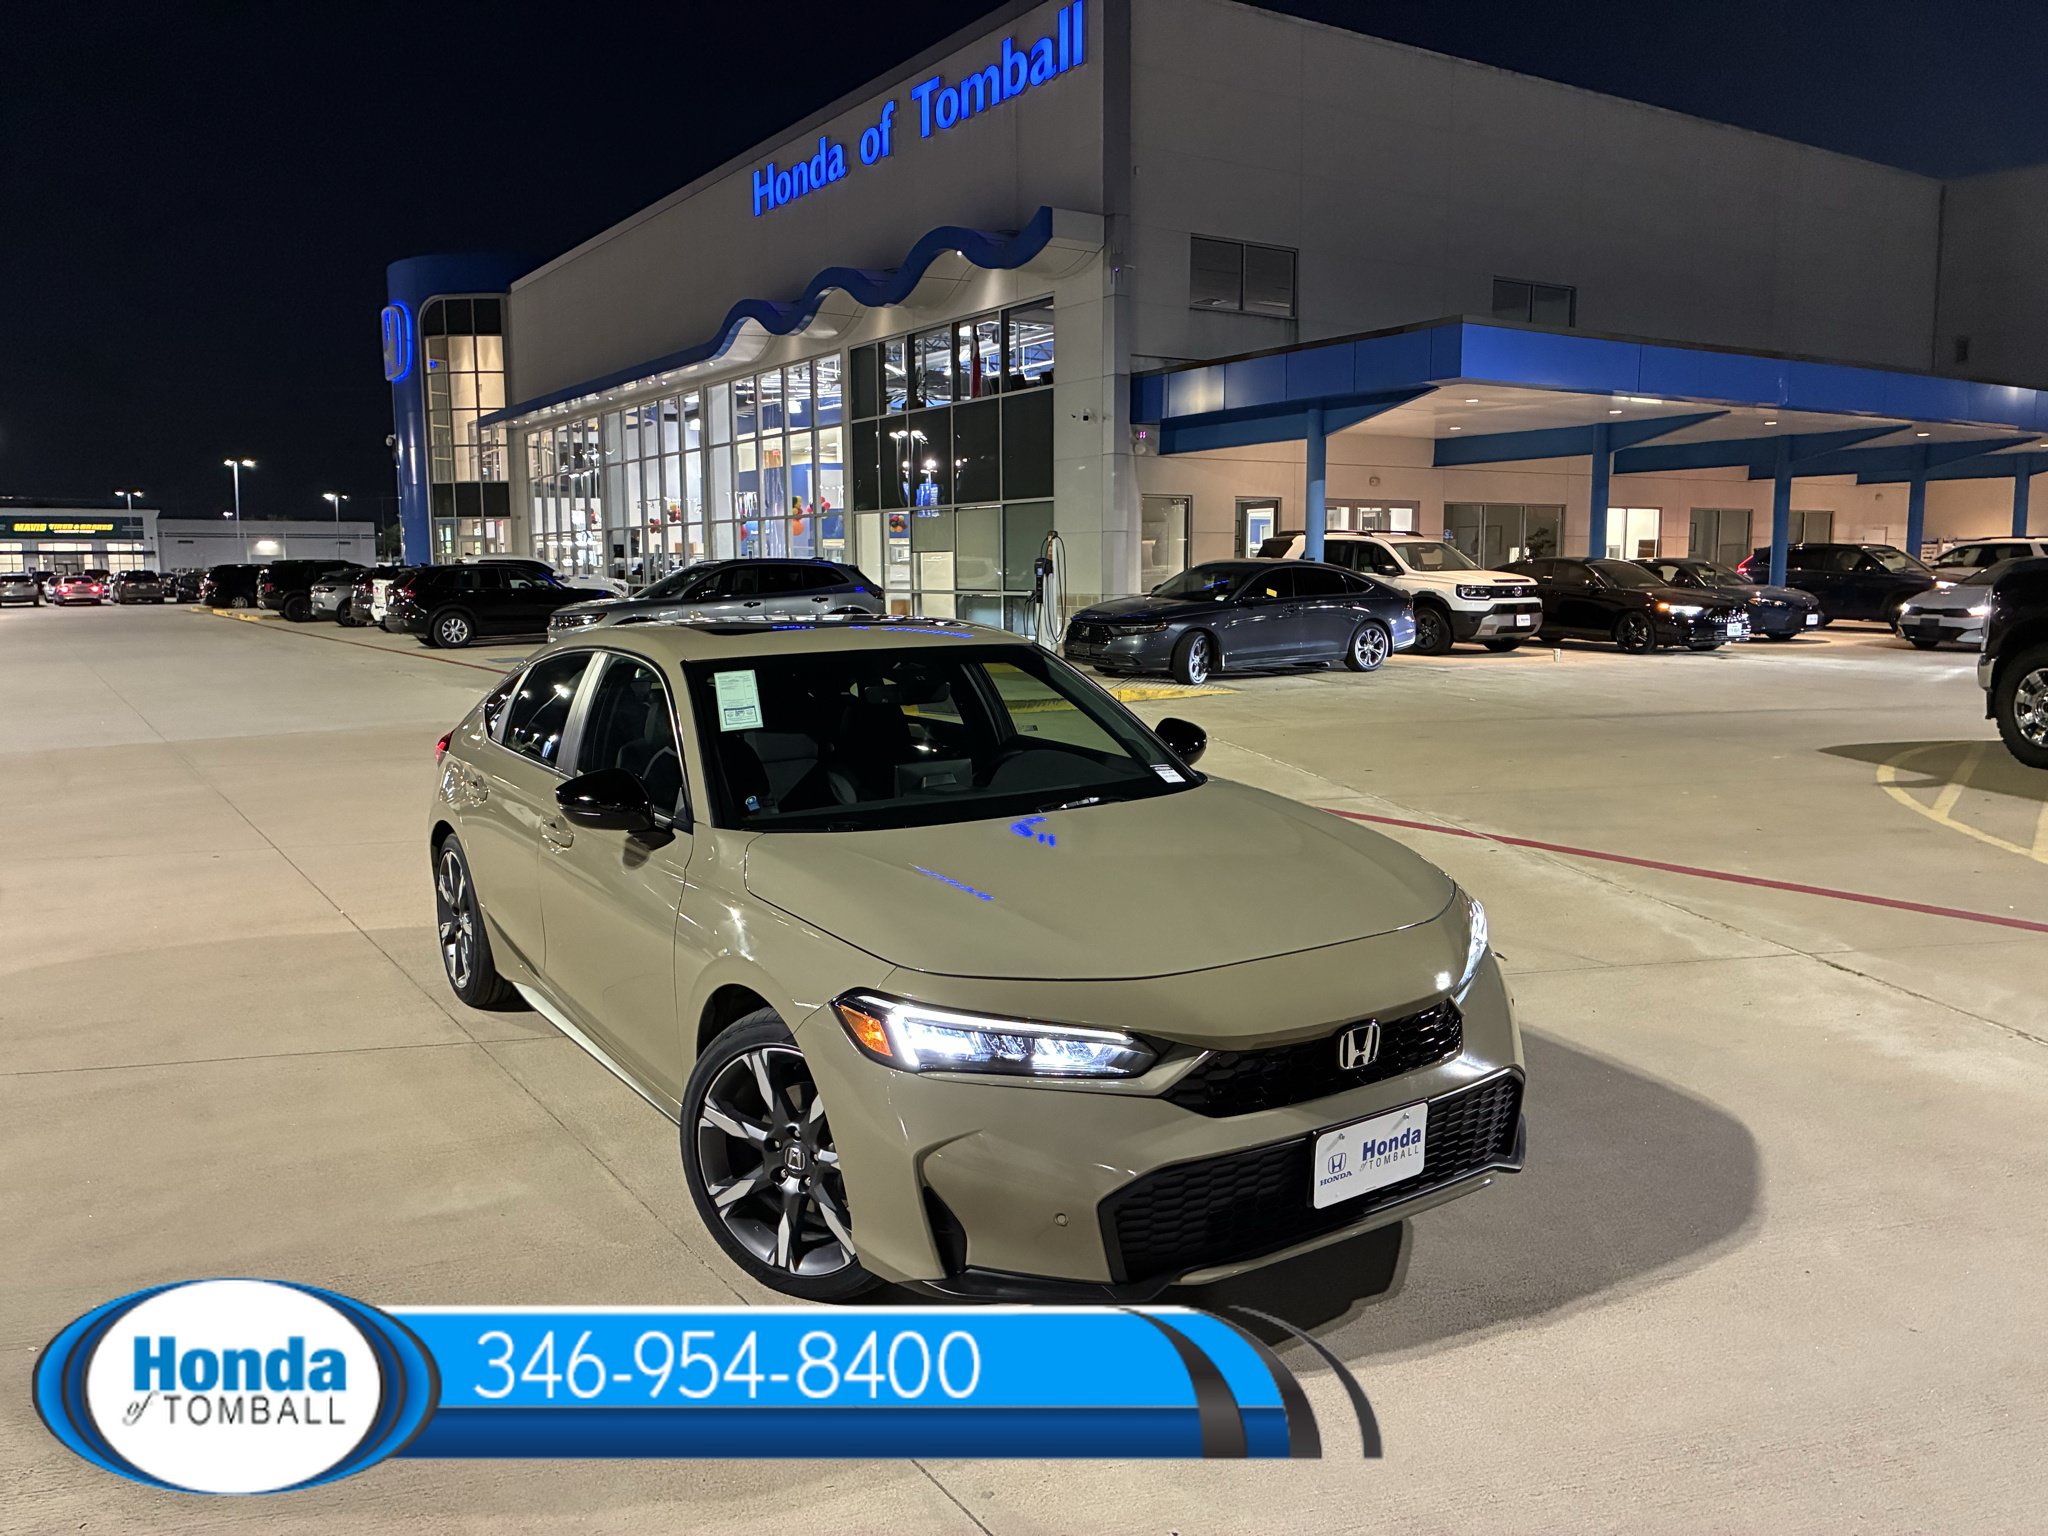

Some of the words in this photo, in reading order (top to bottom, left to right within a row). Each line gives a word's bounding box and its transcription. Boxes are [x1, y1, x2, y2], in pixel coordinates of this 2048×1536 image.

[752, 136, 846, 217] Honda
[859, 100, 895, 165] of
[911, 0, 1084, 138] Tomball
[13, 523, 47, 532] MAVIS
[1362, 1127, 1421, 1161] Honda
[1369, 1145, 1419, 1170] TOMBALL
[1320, 1170, 1352, 1186] HONDA
